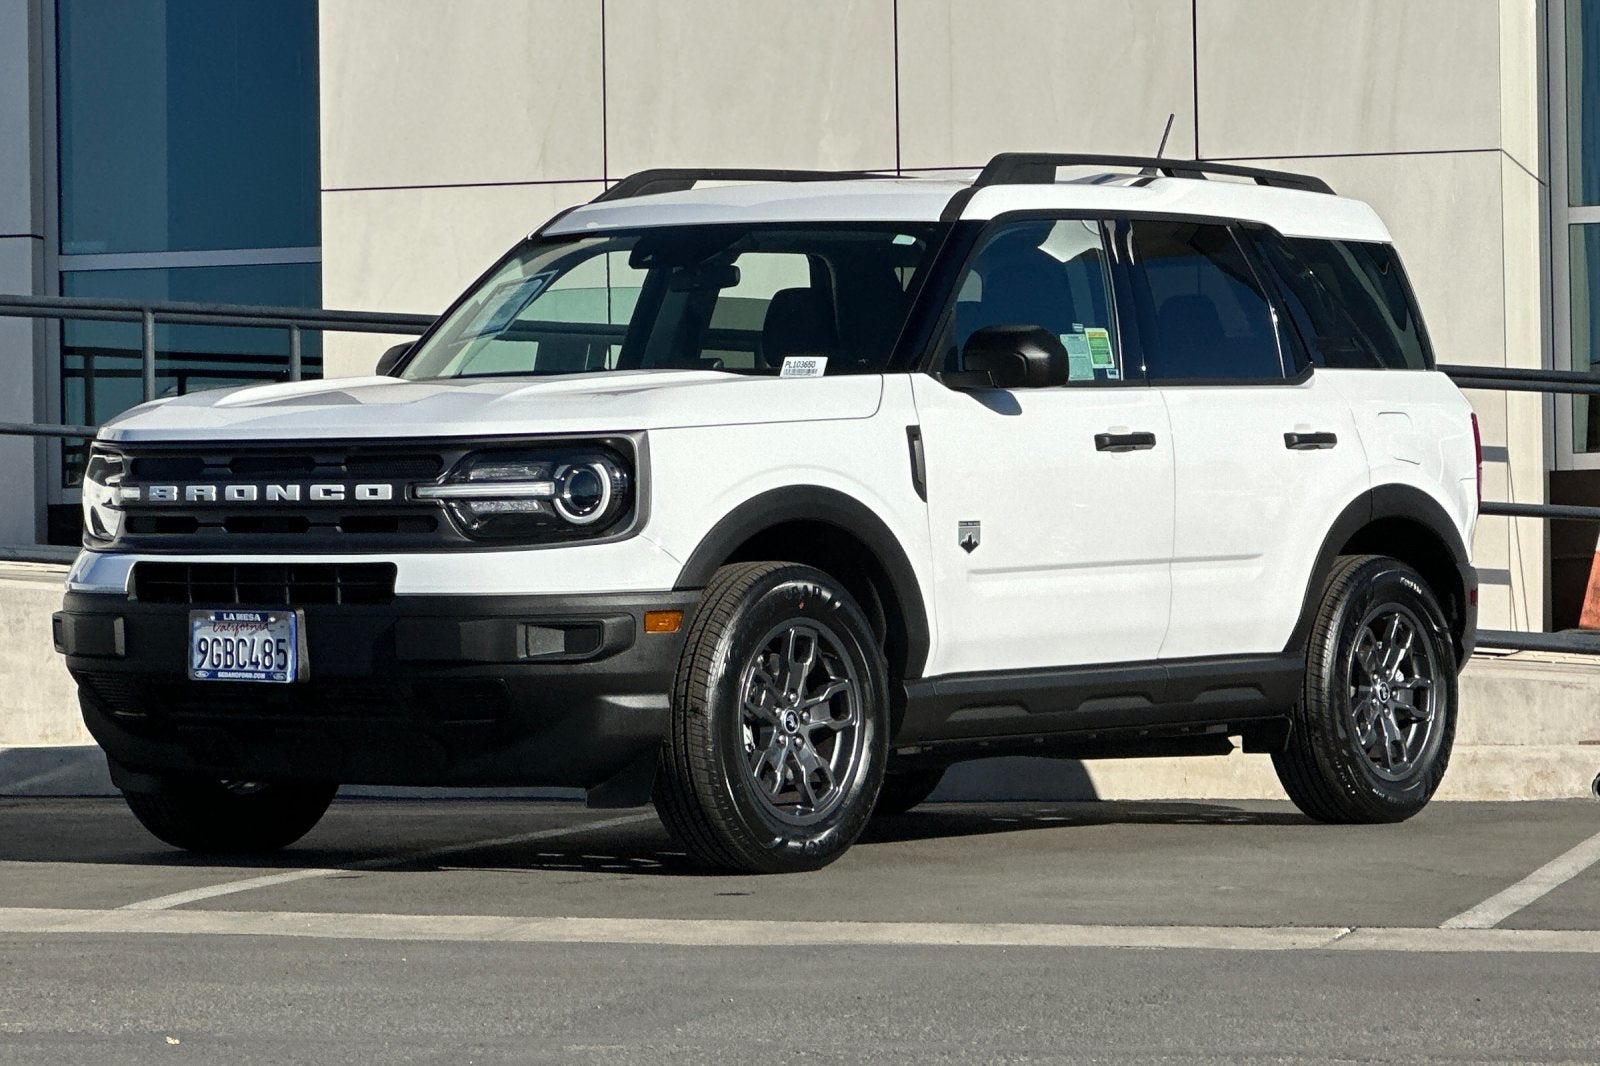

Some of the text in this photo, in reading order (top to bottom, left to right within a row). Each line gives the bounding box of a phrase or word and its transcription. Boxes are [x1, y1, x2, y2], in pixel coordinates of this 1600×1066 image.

[149, 484, 392, 501] BRONCO
[223, 613, 261, 621] LA MESA
[212, 621, 269, 636] California
[197, 637, 288, 670] 9GBC485
